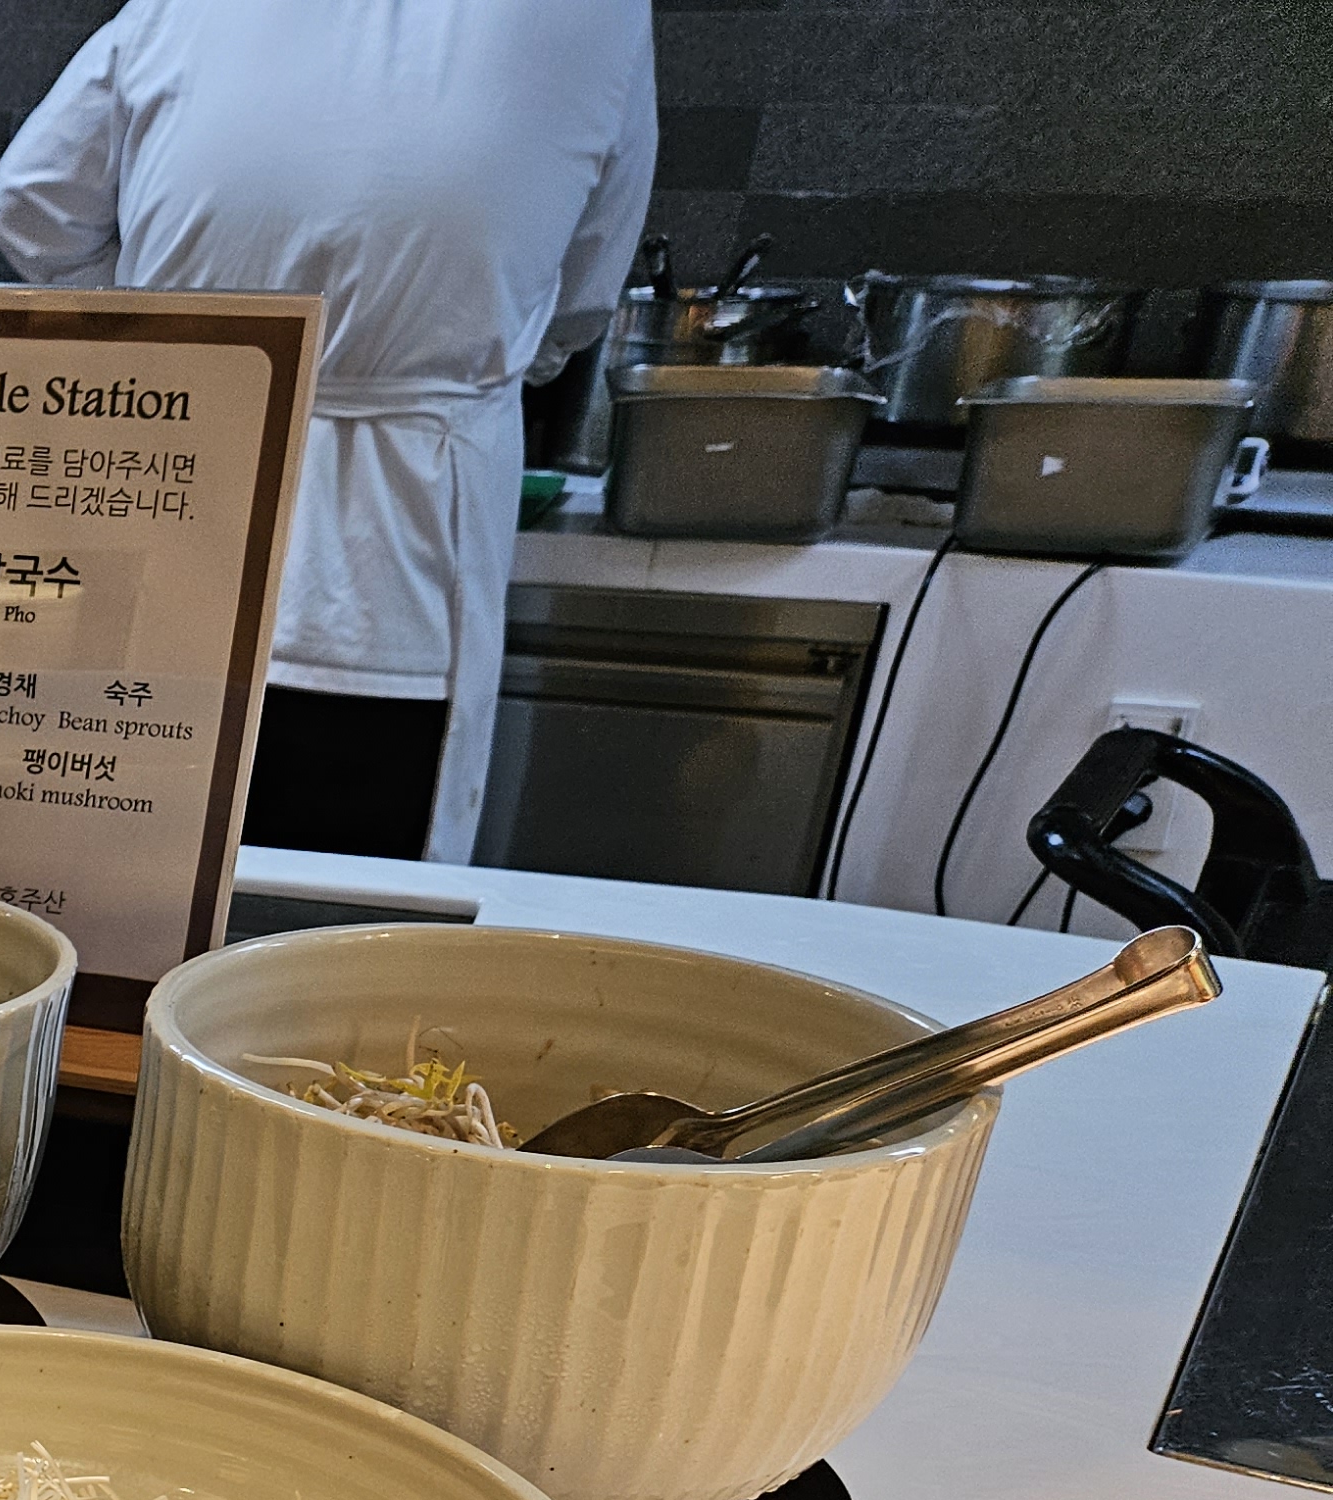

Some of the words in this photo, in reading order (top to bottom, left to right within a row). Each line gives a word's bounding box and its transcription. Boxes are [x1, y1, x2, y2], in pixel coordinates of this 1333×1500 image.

[42, 376, 191, 421] Station
[63, 448, 196, 484] 담아주시면
[26, 484, 195, 521] 드리겠습니다.
[3, 606, 36, 623] Pho
[104, 679, 153, 707] 숙주
[58, 711, 108, 734] Bean
[114, 717, 193, 741] sprouts
[22, 748, 117, 781] 팽이버섯
[40, 787, 153, 813] mushroom
[0, 886, 67, 915] 호주산
